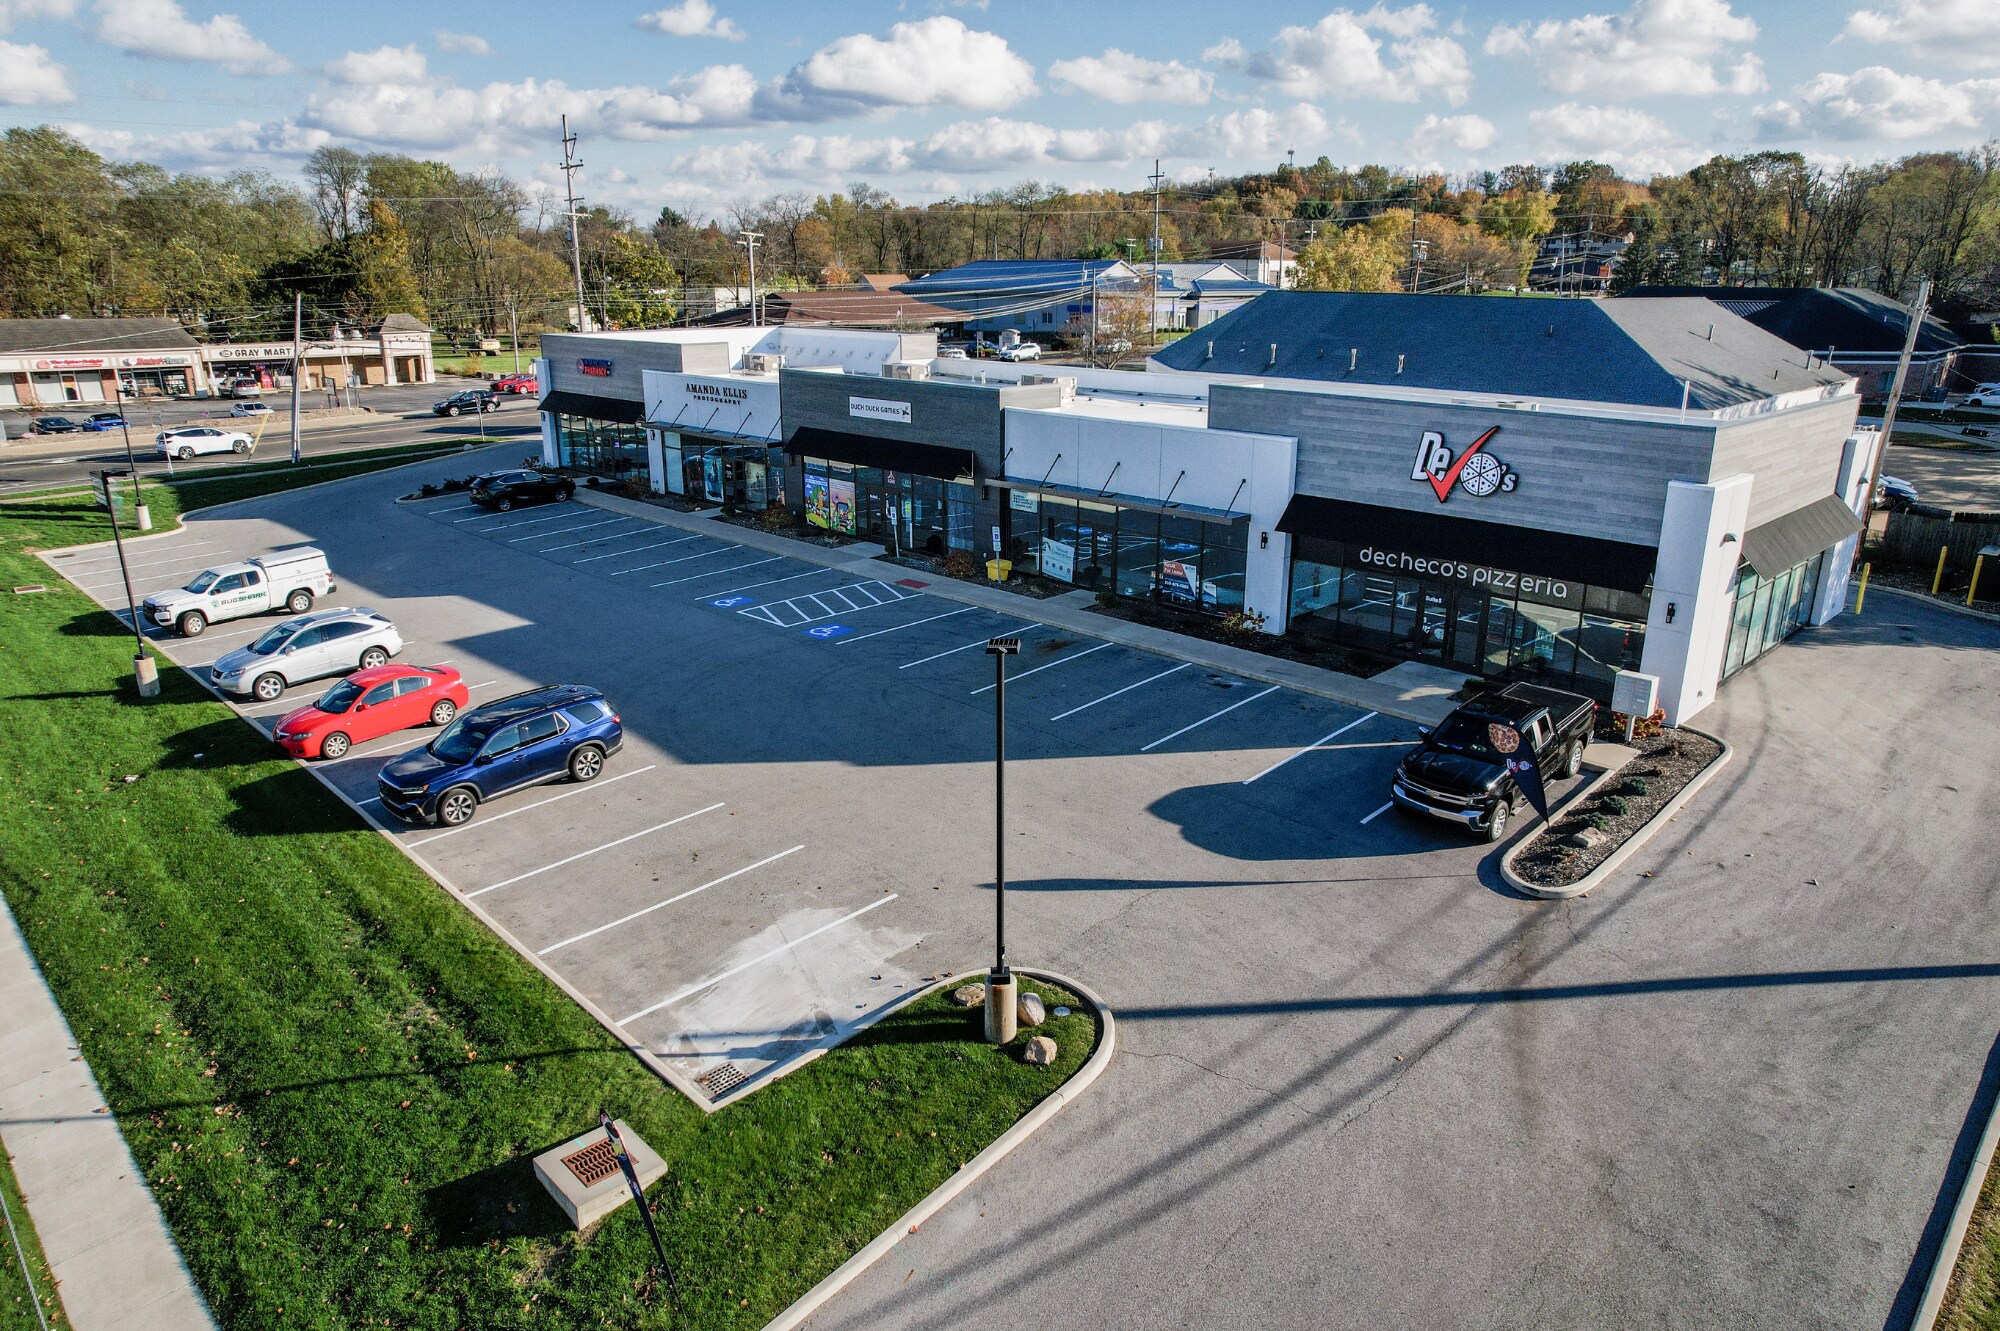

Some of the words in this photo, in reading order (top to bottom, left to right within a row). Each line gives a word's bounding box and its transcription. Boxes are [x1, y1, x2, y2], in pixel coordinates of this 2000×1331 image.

[235, 349, 259, 357] GRAY
[264, 348, 291, 356] MART
[686, 383, 720, 395] AMANDA
[722, 387, 747, 399] ELLIS
[693, 395, 741, 405] PHOTOGRAPHY
[1359, 547, 1468, 579] decheco's
[1472, 567, 1568, 599] pizzeria
